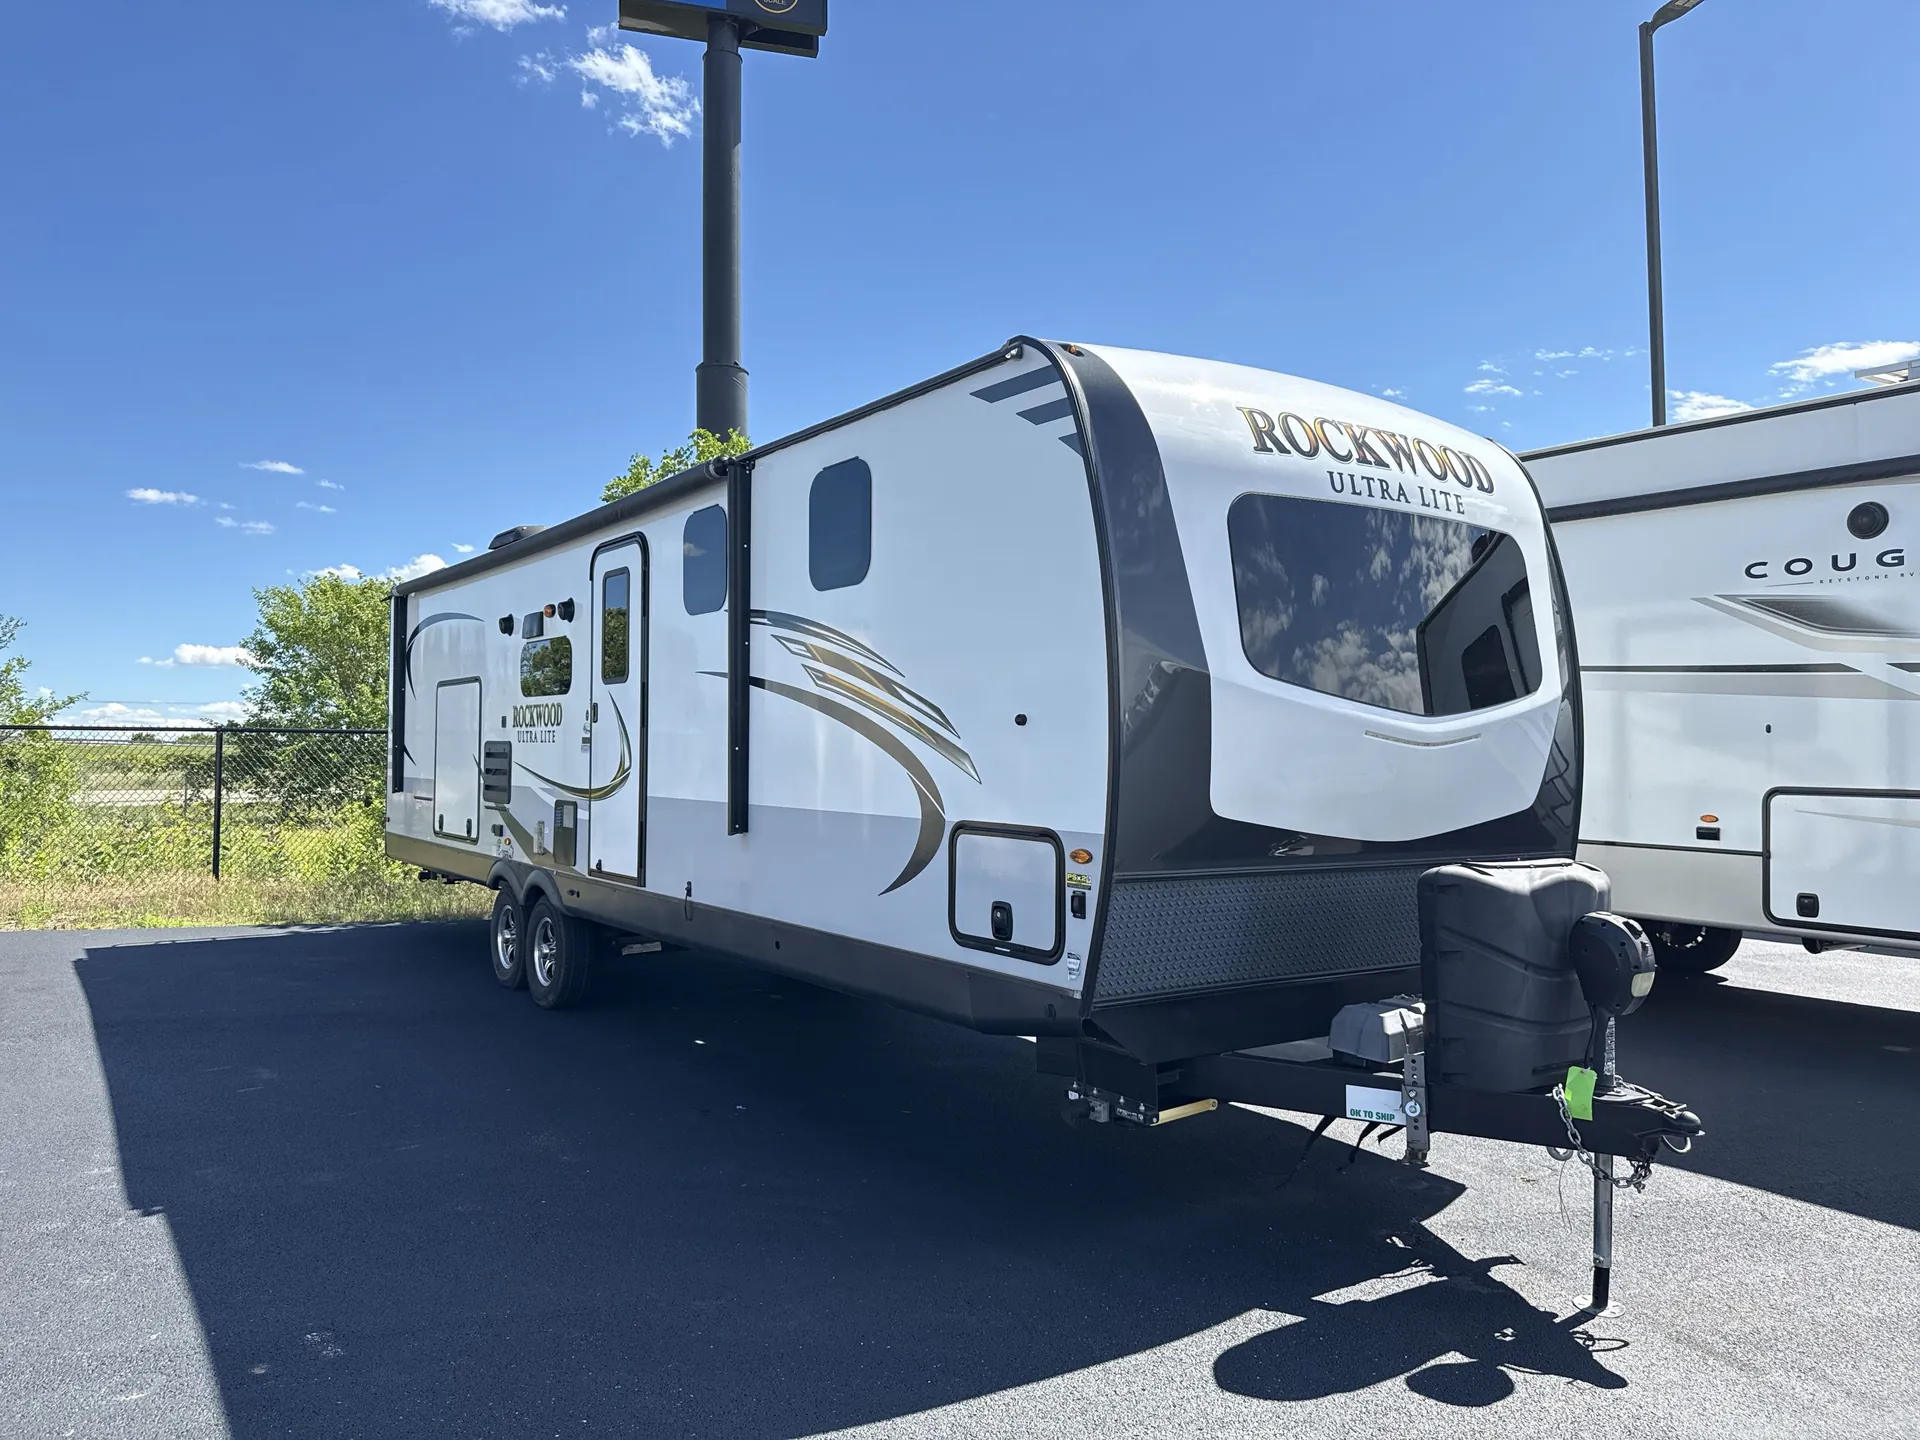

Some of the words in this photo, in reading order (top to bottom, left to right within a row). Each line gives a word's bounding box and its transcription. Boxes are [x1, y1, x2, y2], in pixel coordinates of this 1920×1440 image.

[1236, 406, 1495, 495] ROCKWOOD
[1327, 471, 1411, 505] ULTRA
[1418, 486, 1466, 515] LITE
[1744, 548, 1905, 579] COUG
[1819, 574, 1889, 584] KEYSTONE
[512, 702, 563, 728] ROCKWOOD
[517, 730, 538, 743] ULTRA
[540, 730, 556, 743] LITE
[1350, 1108, 1361, 1117] OK
[1363, 1110, 1373, 1119] TO
[1375, 1111, 1396, 1121] SHIP
